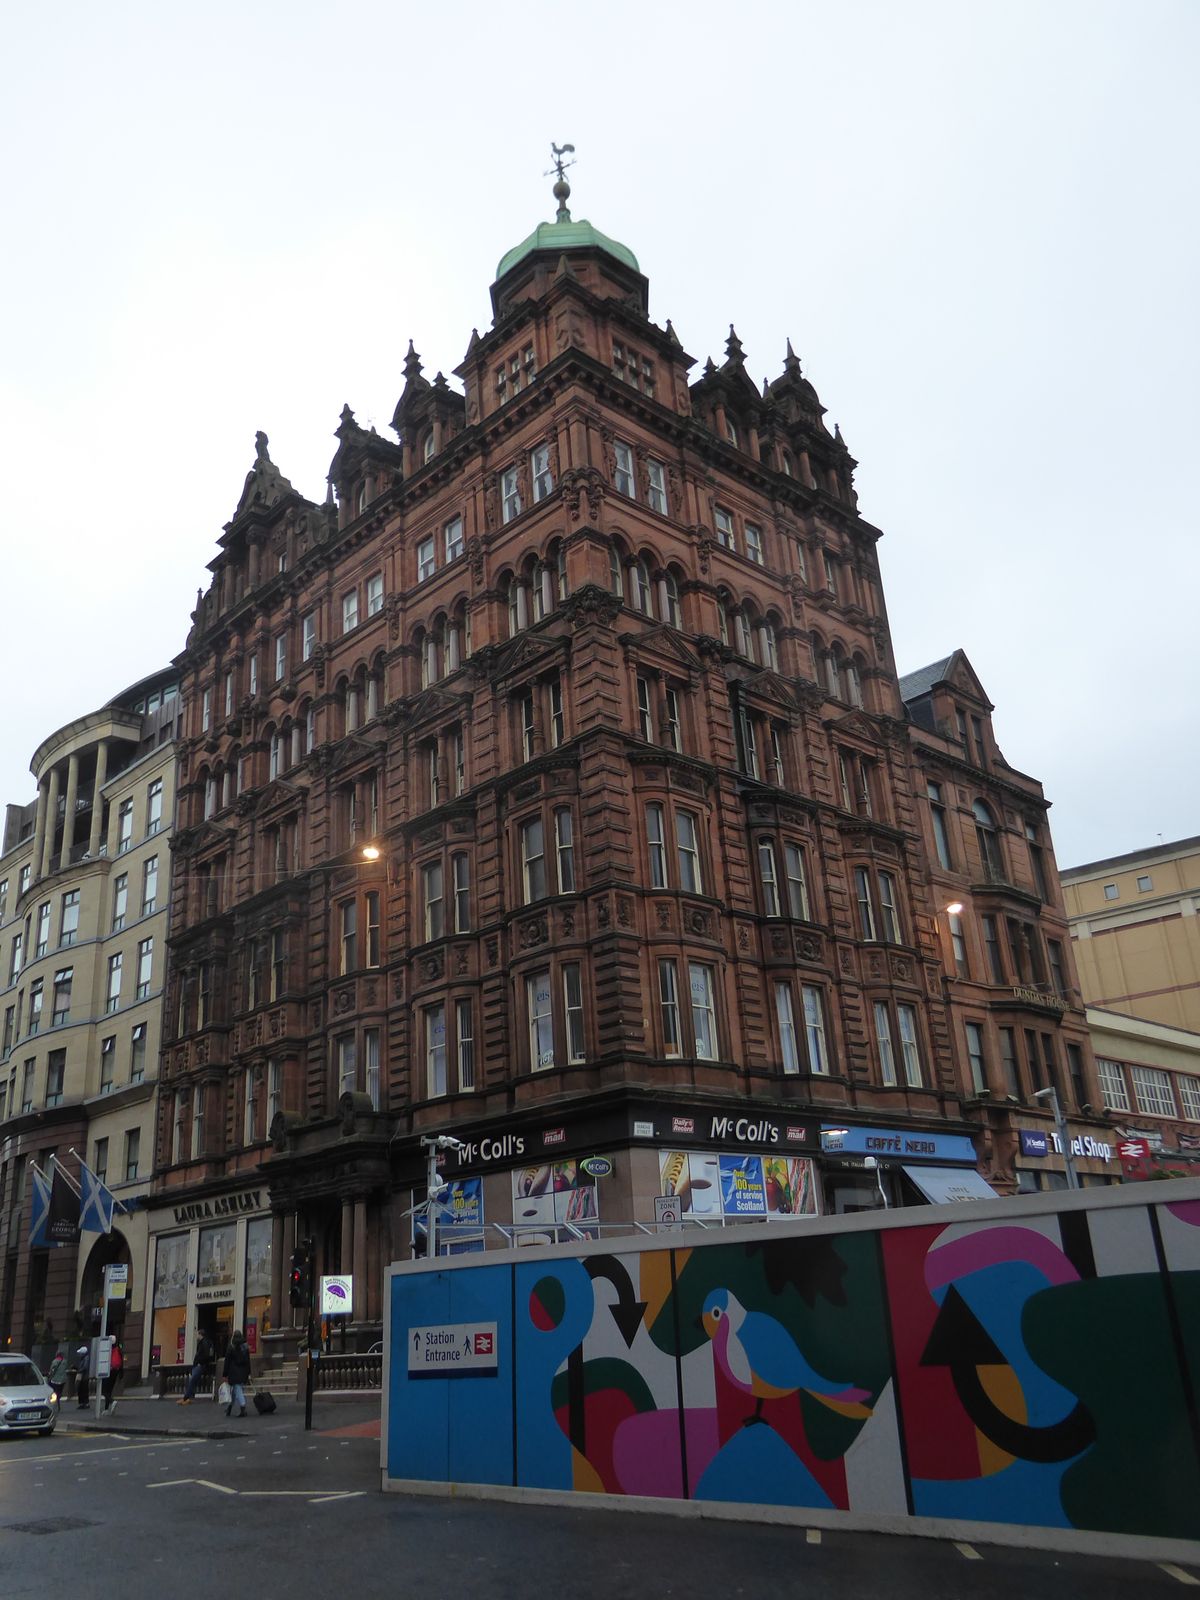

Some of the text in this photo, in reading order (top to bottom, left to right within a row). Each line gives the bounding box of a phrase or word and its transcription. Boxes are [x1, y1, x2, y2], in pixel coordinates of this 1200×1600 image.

[710, 1116, 779, 1143] McColl's
[458, 1135, 525, 1165] McColl's
[905, 1140, 936, 1153] NERO
[1050, 1132, 1111, 1163] Trvel Shop
[736, 1179, 747, 1190] 100
[743, 1191, 763, 1201] serving
[173, 1202, 214, 1224] LAURA
[215, 1190, 261, 1214] ASHLEY
[736, 1201, 764, 1211] Scotland
[197, 1289, 231, 1300] LAURA ASHLEY
[426, 1331, 455, 1345] Station
[425, 1349, 460, 1362] Entrance
